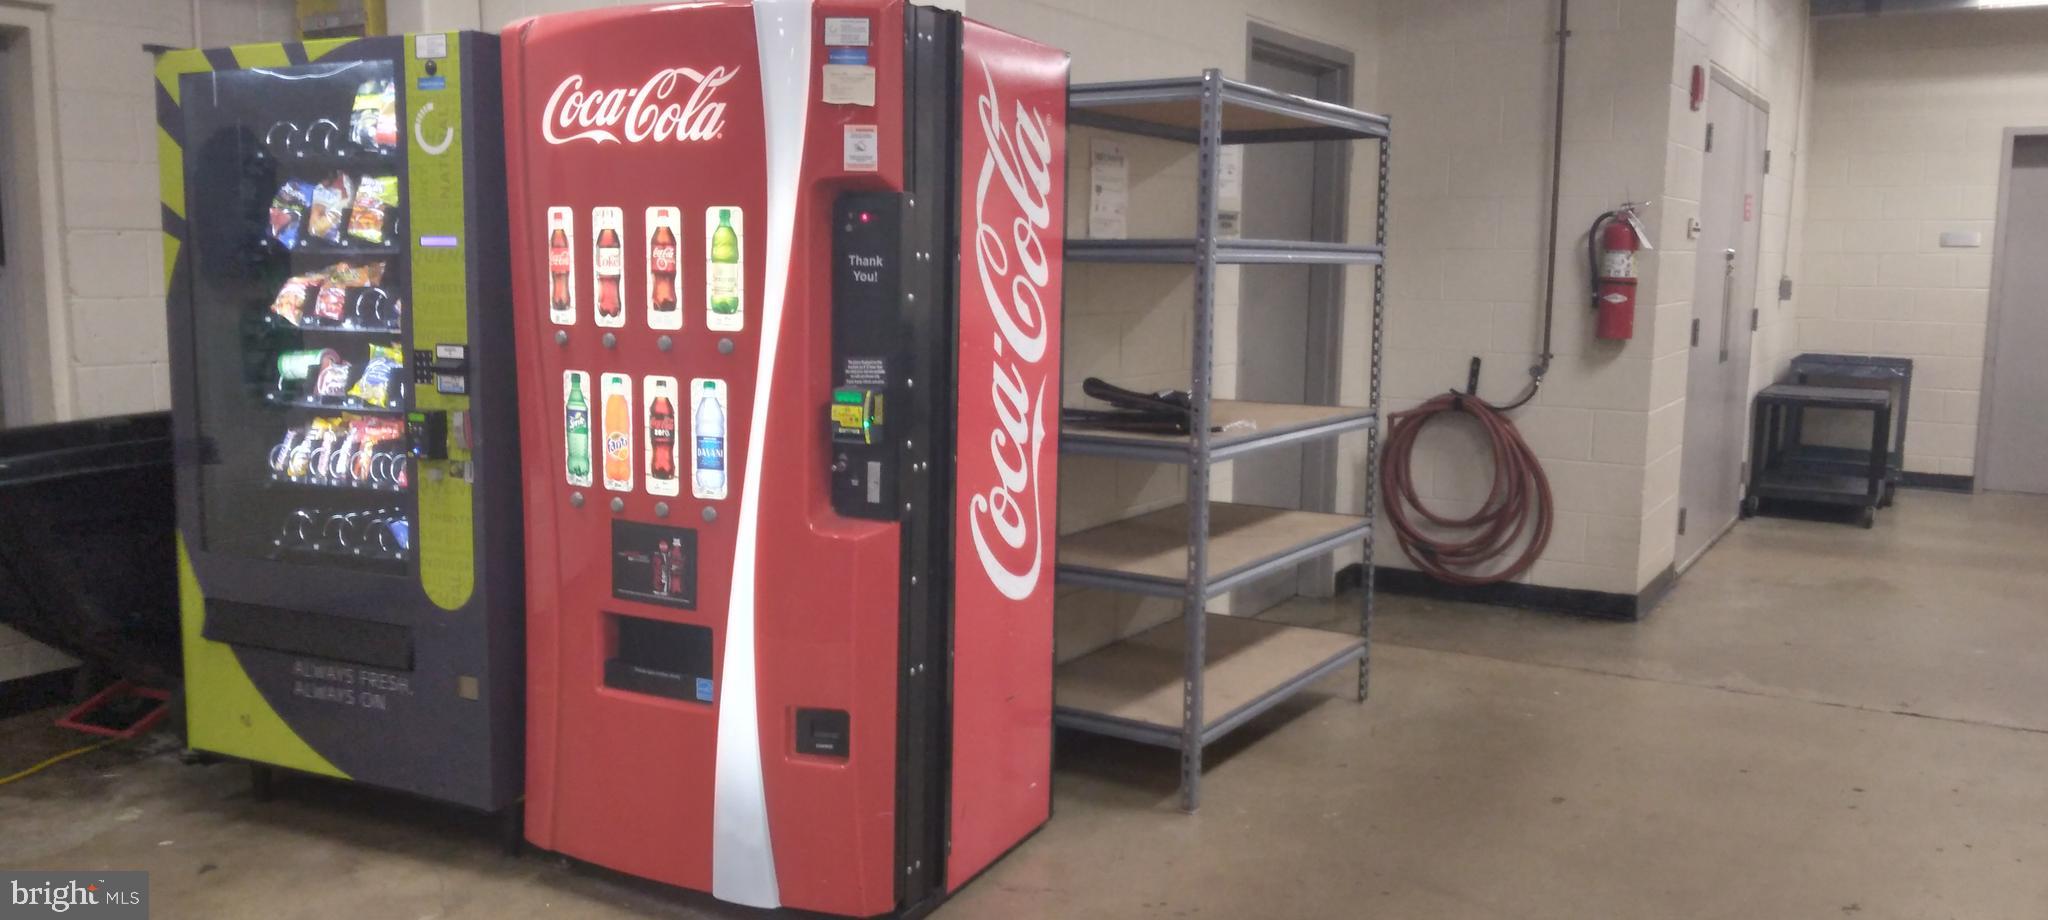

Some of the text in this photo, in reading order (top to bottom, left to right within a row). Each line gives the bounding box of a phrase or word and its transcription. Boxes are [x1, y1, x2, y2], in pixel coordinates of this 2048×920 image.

[542, 64, 742, 145] Coca-Cola
[848, 255, 883, 267] Thank
[853, 271, 878, 282] You!
[969, 55, 1053, 601] Coca-Cola
[294, 660, 354, 684] ALWAYS
[293, 680, 387, 710] ALWAYS ON
